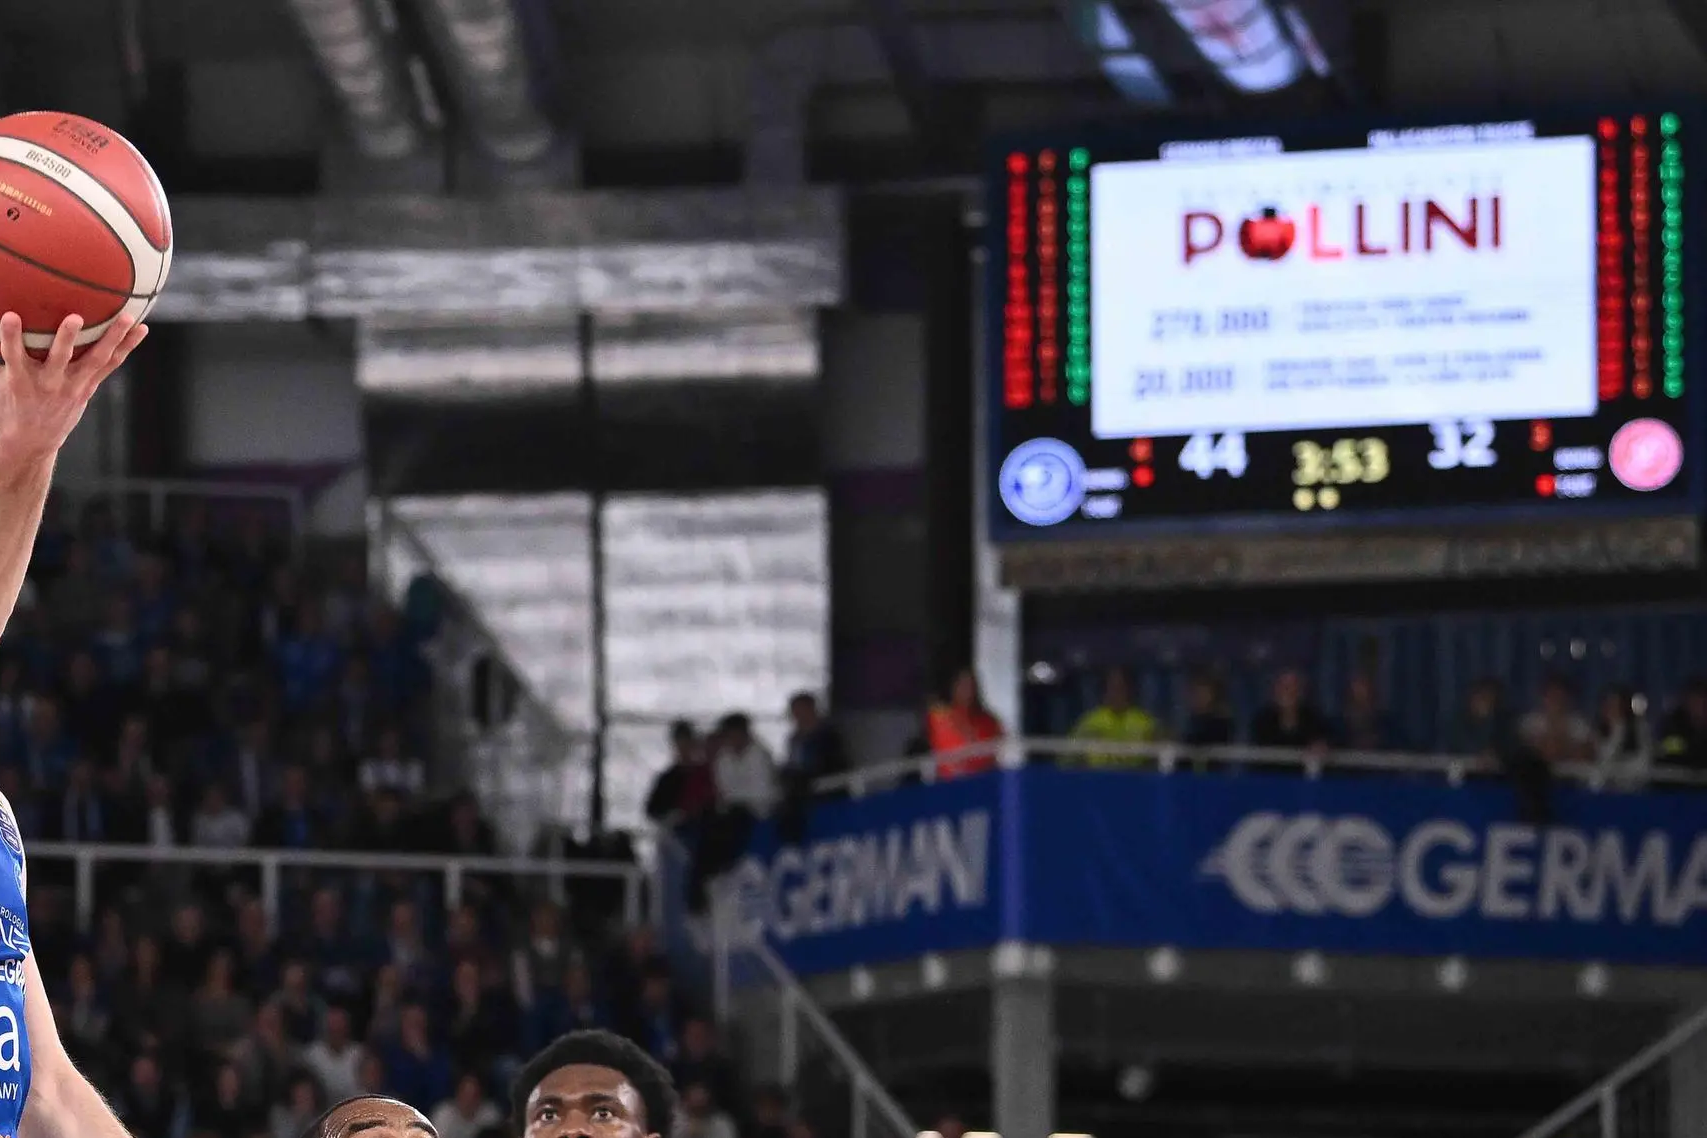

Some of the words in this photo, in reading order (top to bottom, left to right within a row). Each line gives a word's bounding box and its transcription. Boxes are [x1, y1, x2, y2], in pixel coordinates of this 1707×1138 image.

[1178, 427, 1249, 480] 44
[1292, 436, 1391, 488] 3:53
[1427, 416, 1498, 470] 32
